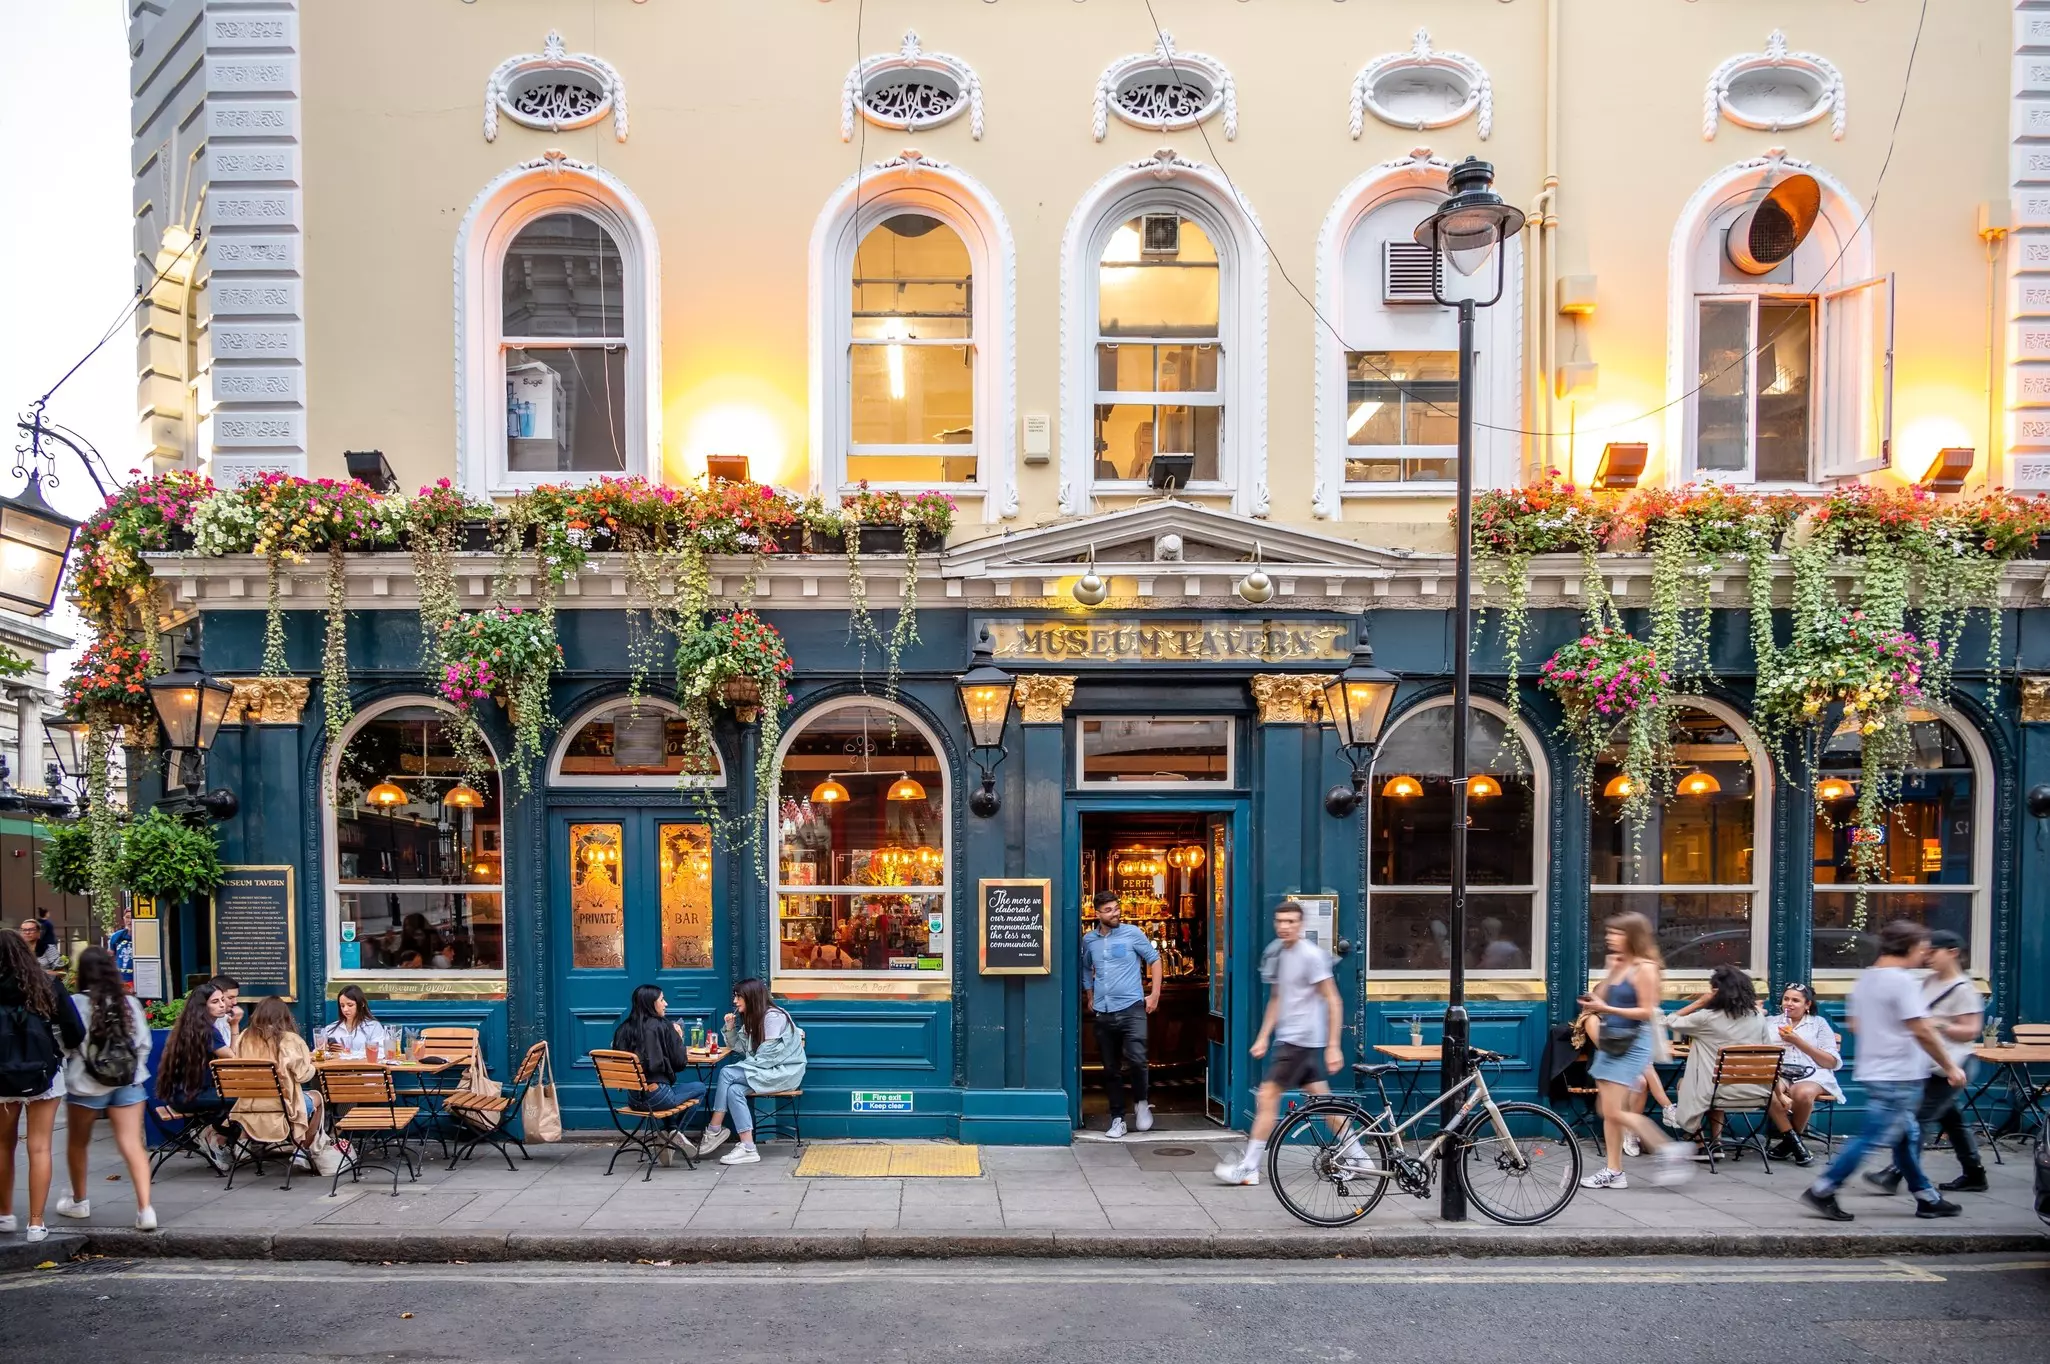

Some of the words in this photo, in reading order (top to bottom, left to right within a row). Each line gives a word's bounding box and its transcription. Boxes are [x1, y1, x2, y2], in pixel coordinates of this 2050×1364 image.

[1018, 629, 1160, 655] MUSEUM
[1177, 629, 1314, 656] TAVERN
[989, 889, 1011, 908] The
[1012, 897, 1031, 905] more
[1032, 897, 1042, 905] we
[995, 904, 1032, 914] elaborate
[579, 913, 617, 925] PRIVATE
[675, 913, 699, 924] BAR
[1031, 914, 1040, 925] of
[990, 931, 1003, 939] the
[1004, 931, 1019, 939] less
[378, 983, 417, 992] Museum
[872, 1093, 887, 1101] Fire
[888, 1093, 902, 1101] exit
